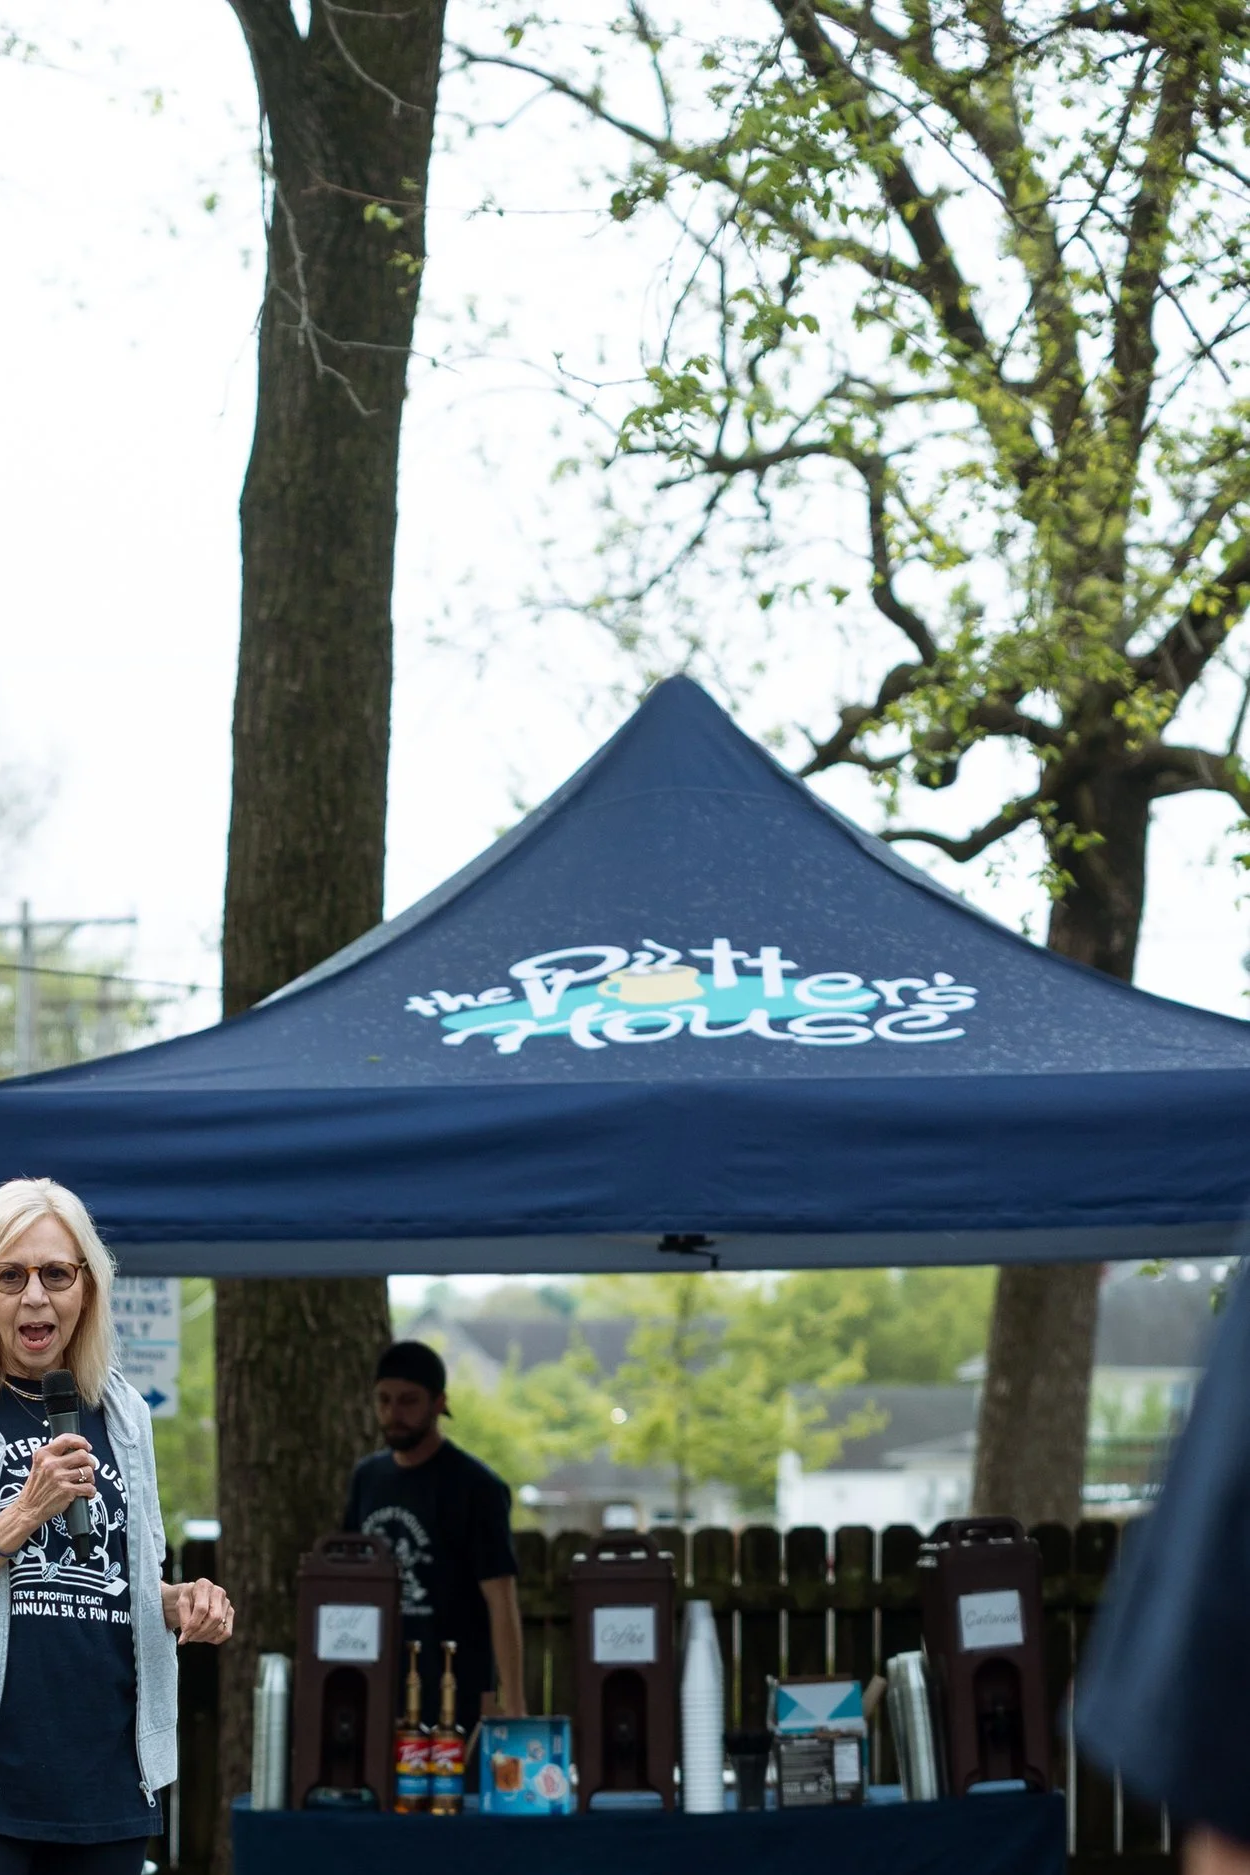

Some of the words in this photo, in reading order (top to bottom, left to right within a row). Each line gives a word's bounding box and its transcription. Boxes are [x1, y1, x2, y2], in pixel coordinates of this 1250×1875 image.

[403, 984, 514, 1018] the
[442, 1001, 967, 1055] House
[13, 1590, 35, 1600] STEVE
[76, 1594, 103, 1606] LEGACY
[11, 1602, 59, 1616] ANNUAL
[61, 1604, 76, 1618] 5K
[77, 1606, 87, 1619] &
[89, 1607, 108, 1622] FUN
